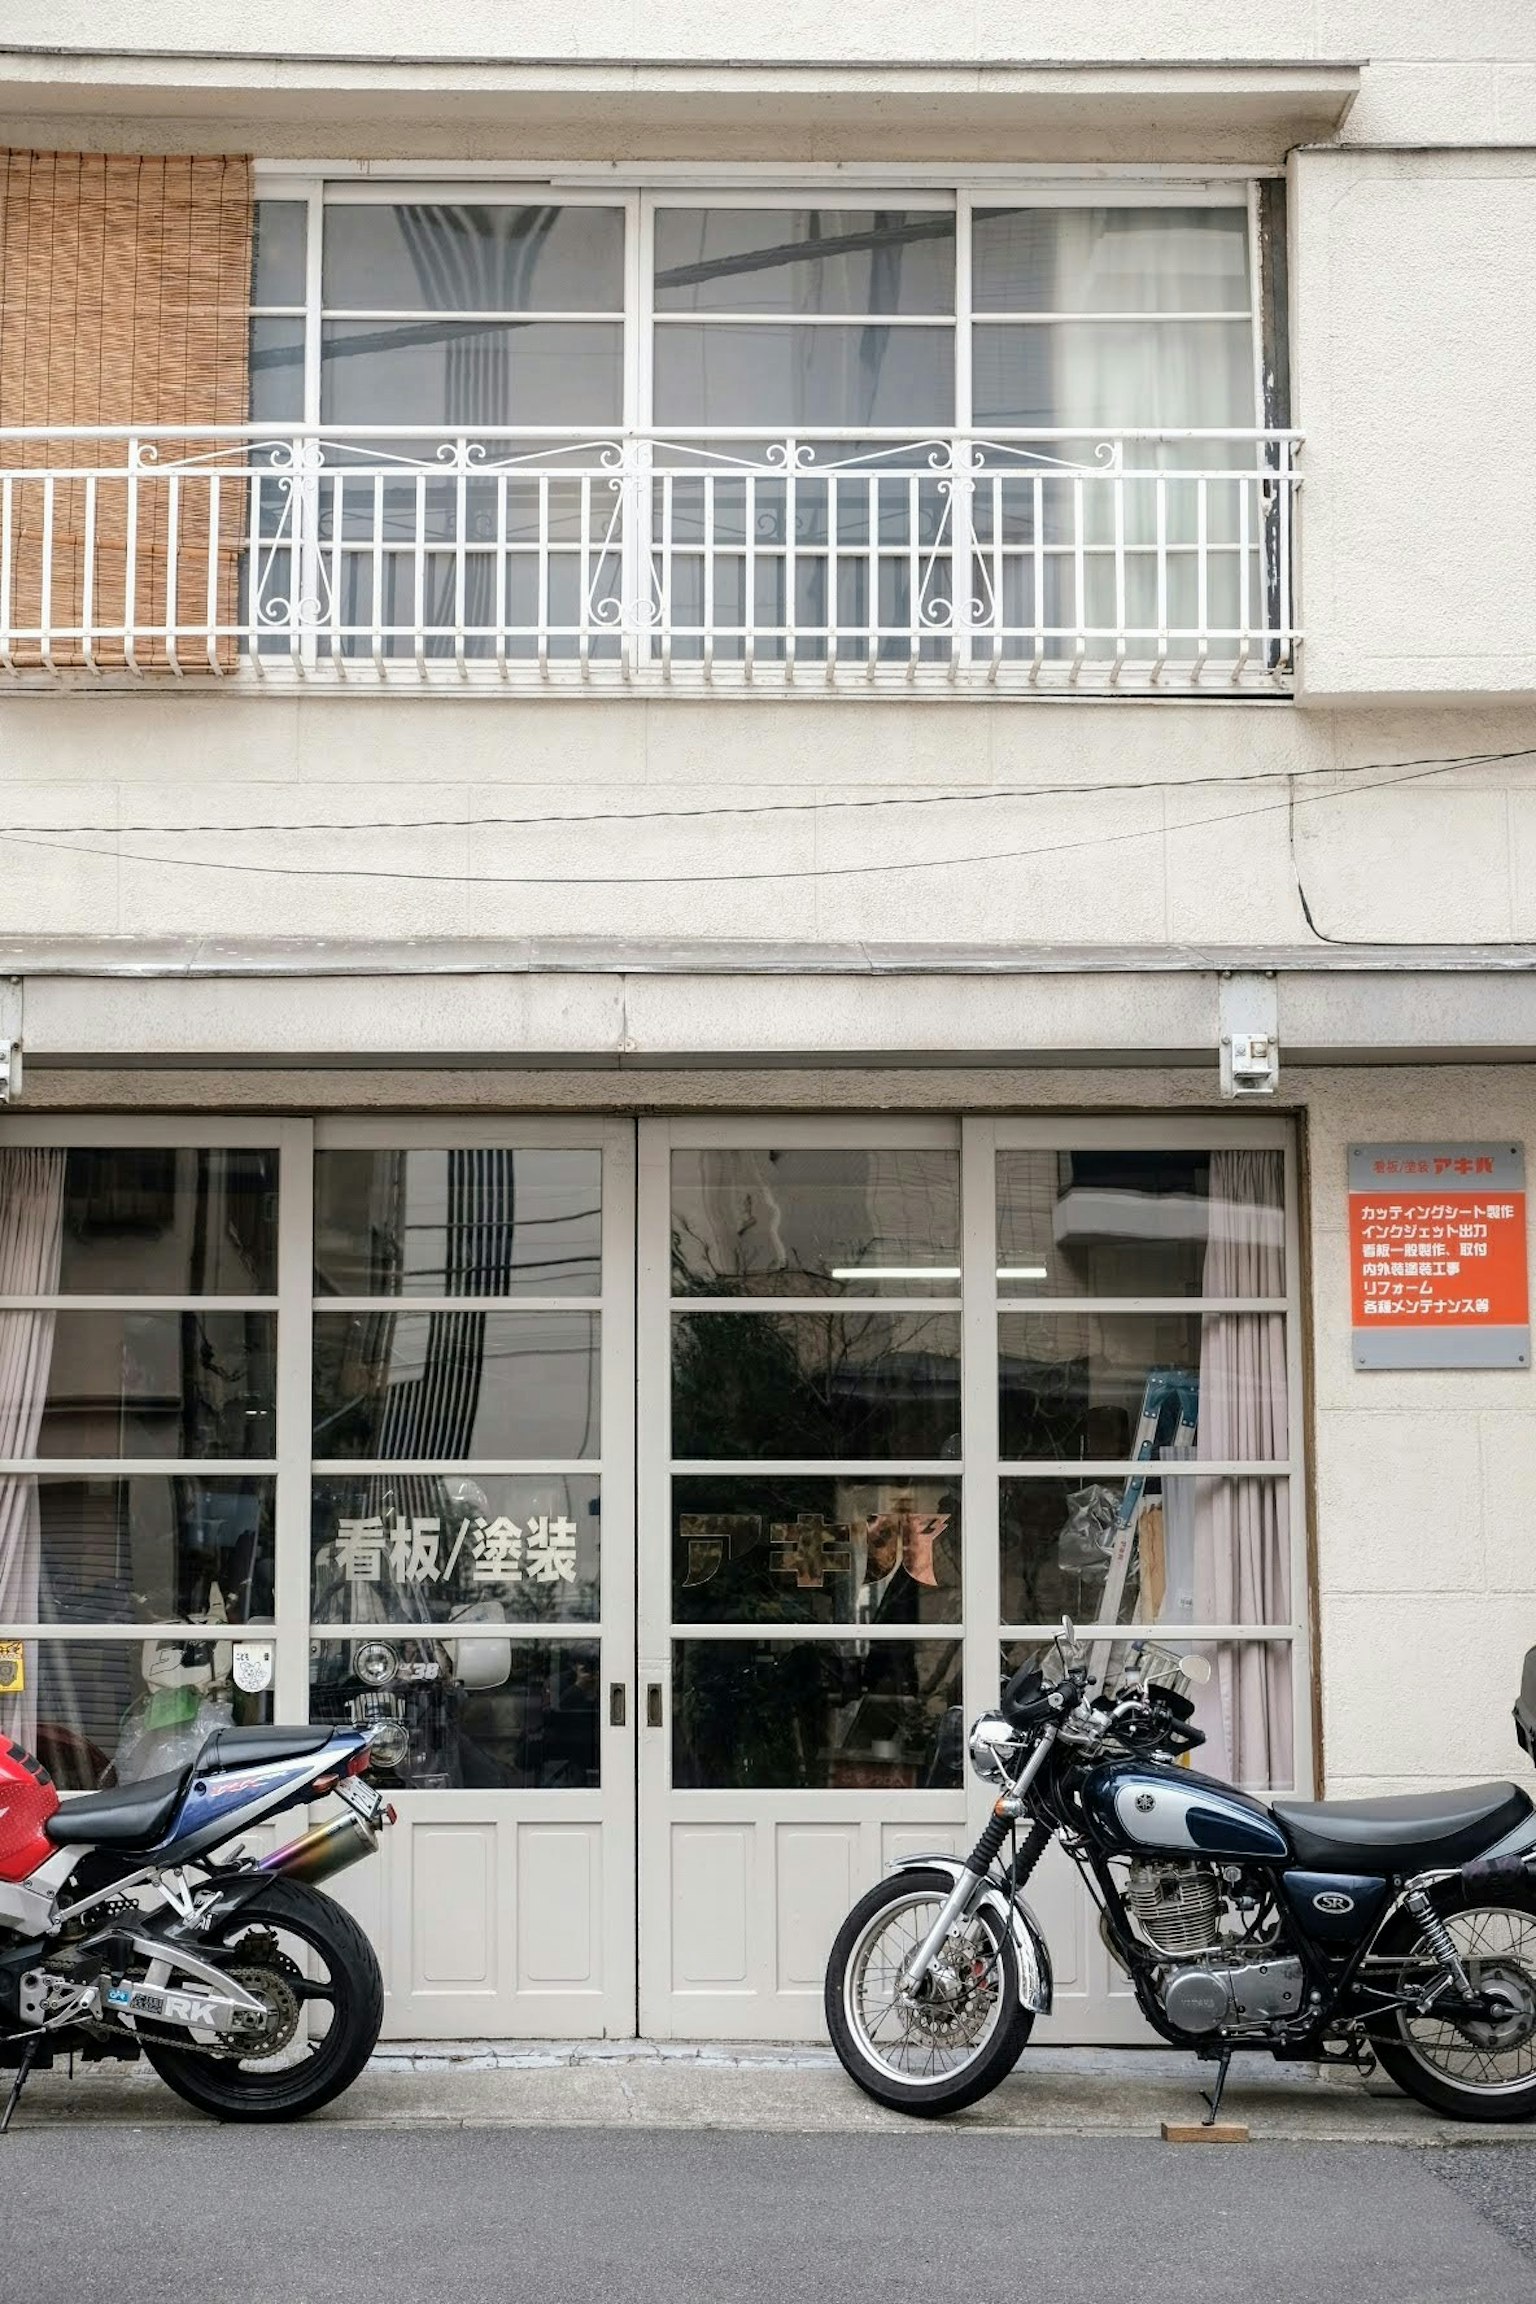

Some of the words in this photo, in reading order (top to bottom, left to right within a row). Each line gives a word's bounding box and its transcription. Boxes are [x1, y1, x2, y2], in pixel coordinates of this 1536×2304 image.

[1361, 1204, 1515, 1221] カッティングシート製作
[1361, 1223, 1488, 1239] インクジェット出力
[1363, 1280, 1434, 1296] リフォーム
[1363, 1298, 1490, 1314] 各種メンテナンス等
[334, 1515, 577, 1584] 看板/塗装
[1321, 1897, 1346, 1910] SR
[164, 1995, 219, 2026] RK
